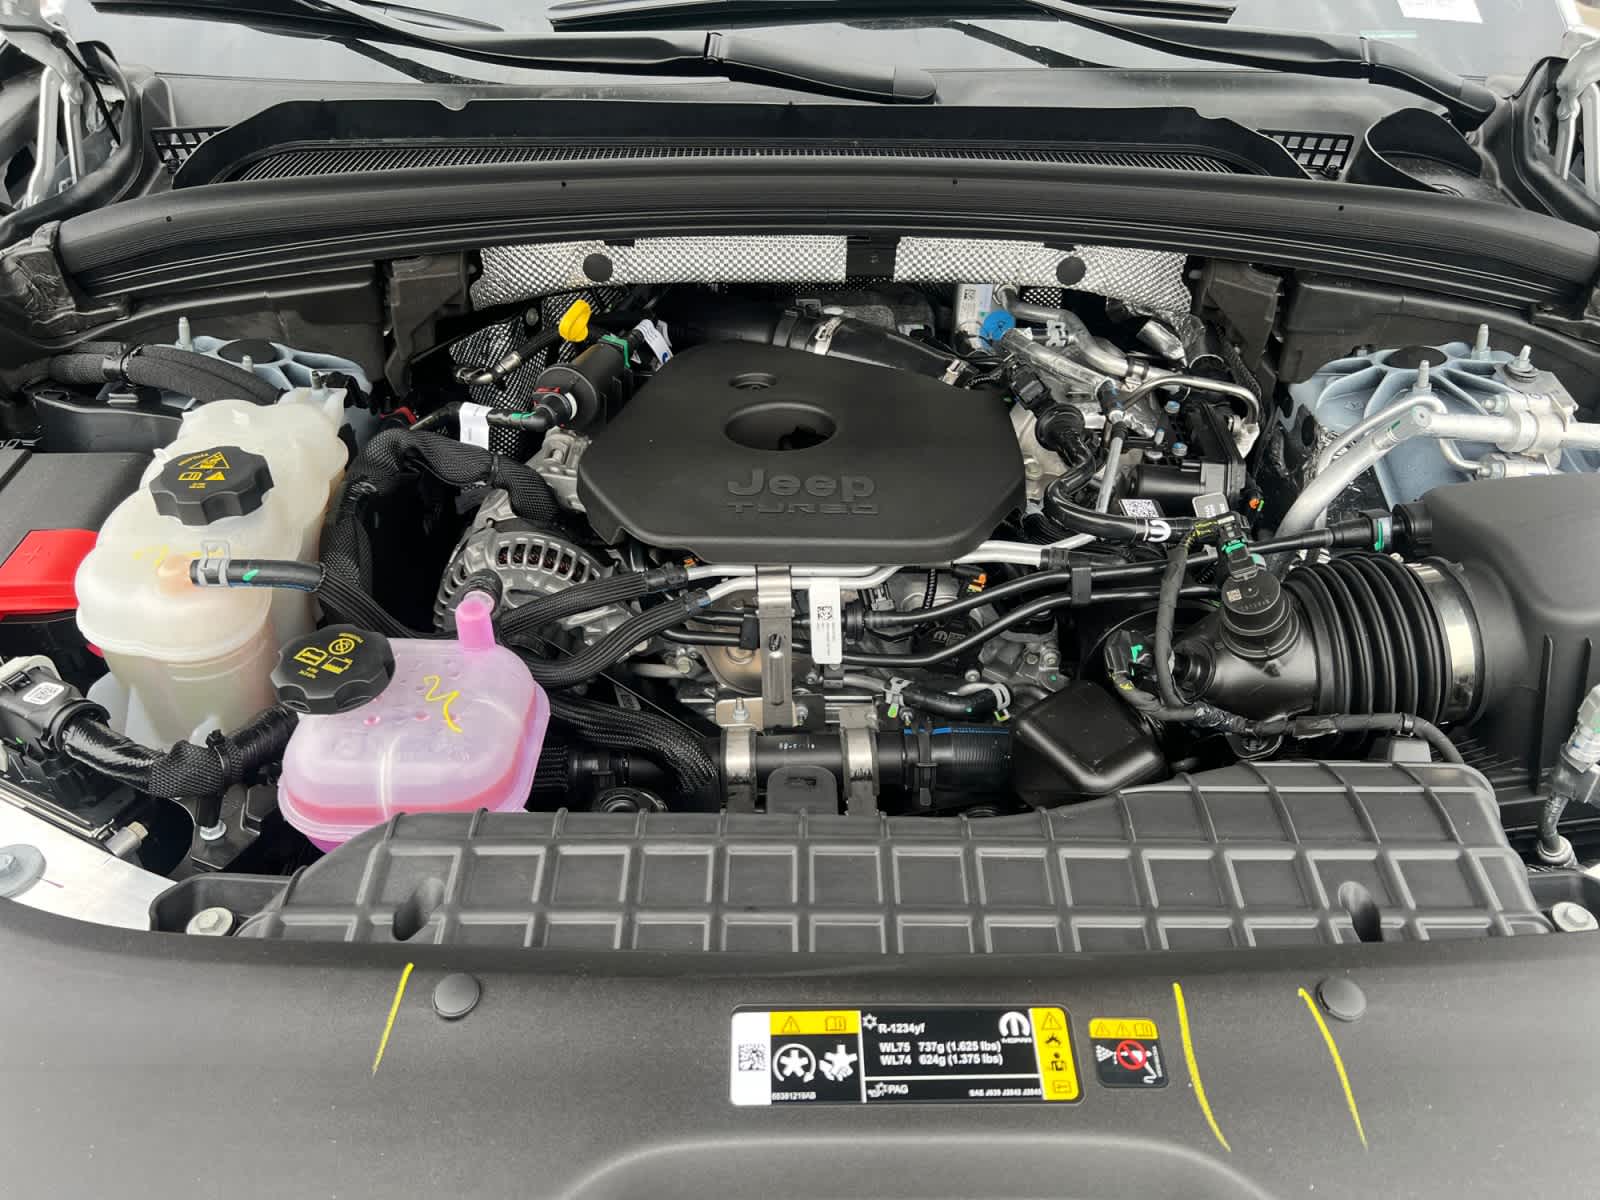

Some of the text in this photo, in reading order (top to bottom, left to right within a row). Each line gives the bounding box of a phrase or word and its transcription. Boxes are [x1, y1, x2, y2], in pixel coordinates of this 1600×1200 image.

[728, 469, 874, 503] Jeep
[878, 1023, 925, 1035] R-1234yf
[879, 1040, 1002, 1054] WL75 737g (1.625 lbs)
[880, 1053, 1003, 1067] WL74 624g (1.375 lbs)
[887, 1084, 909, 1094] PAG
